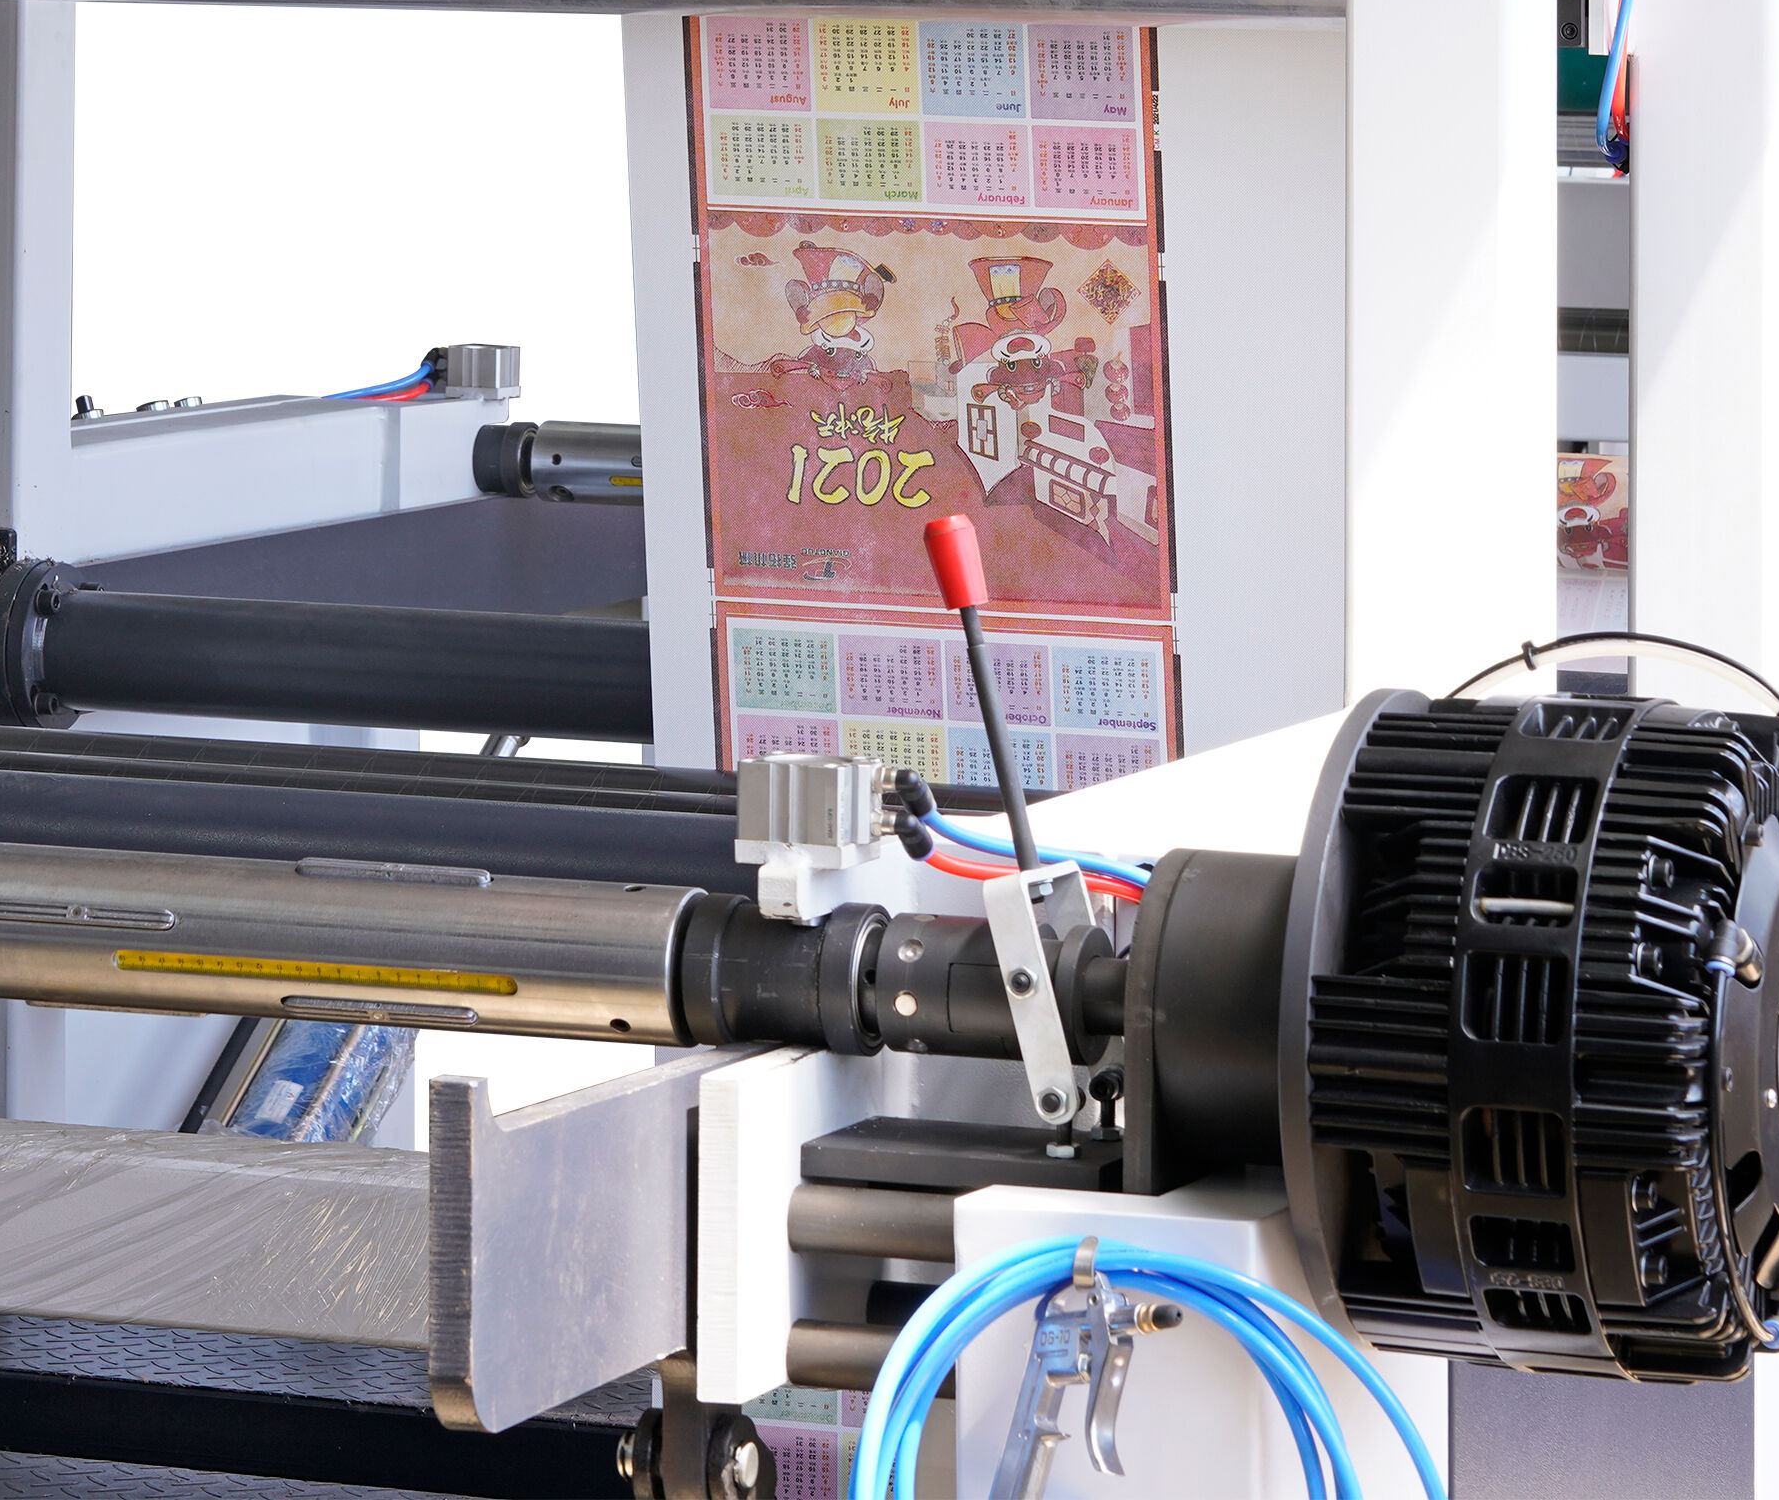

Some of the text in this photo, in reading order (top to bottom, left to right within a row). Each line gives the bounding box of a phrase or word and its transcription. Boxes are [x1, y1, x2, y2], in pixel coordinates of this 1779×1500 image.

[770, 94, 806, 106] August
[888, 98, 910, 108] July
[996, 103, 1021, 112] June
[1103, 104, 1127, 116] May
[785, 185, 809, 196] April
[884, 190, 918, 200] March
[978, 193, 1025, 205] February
[1090, 196, 1134, 208] January
[810, 402, 906, 446] 牛气冲天
[786, 443, 935, 509] 2021
[886, 706, 941, 718] November
[1098, 718, 1156, 731] September
